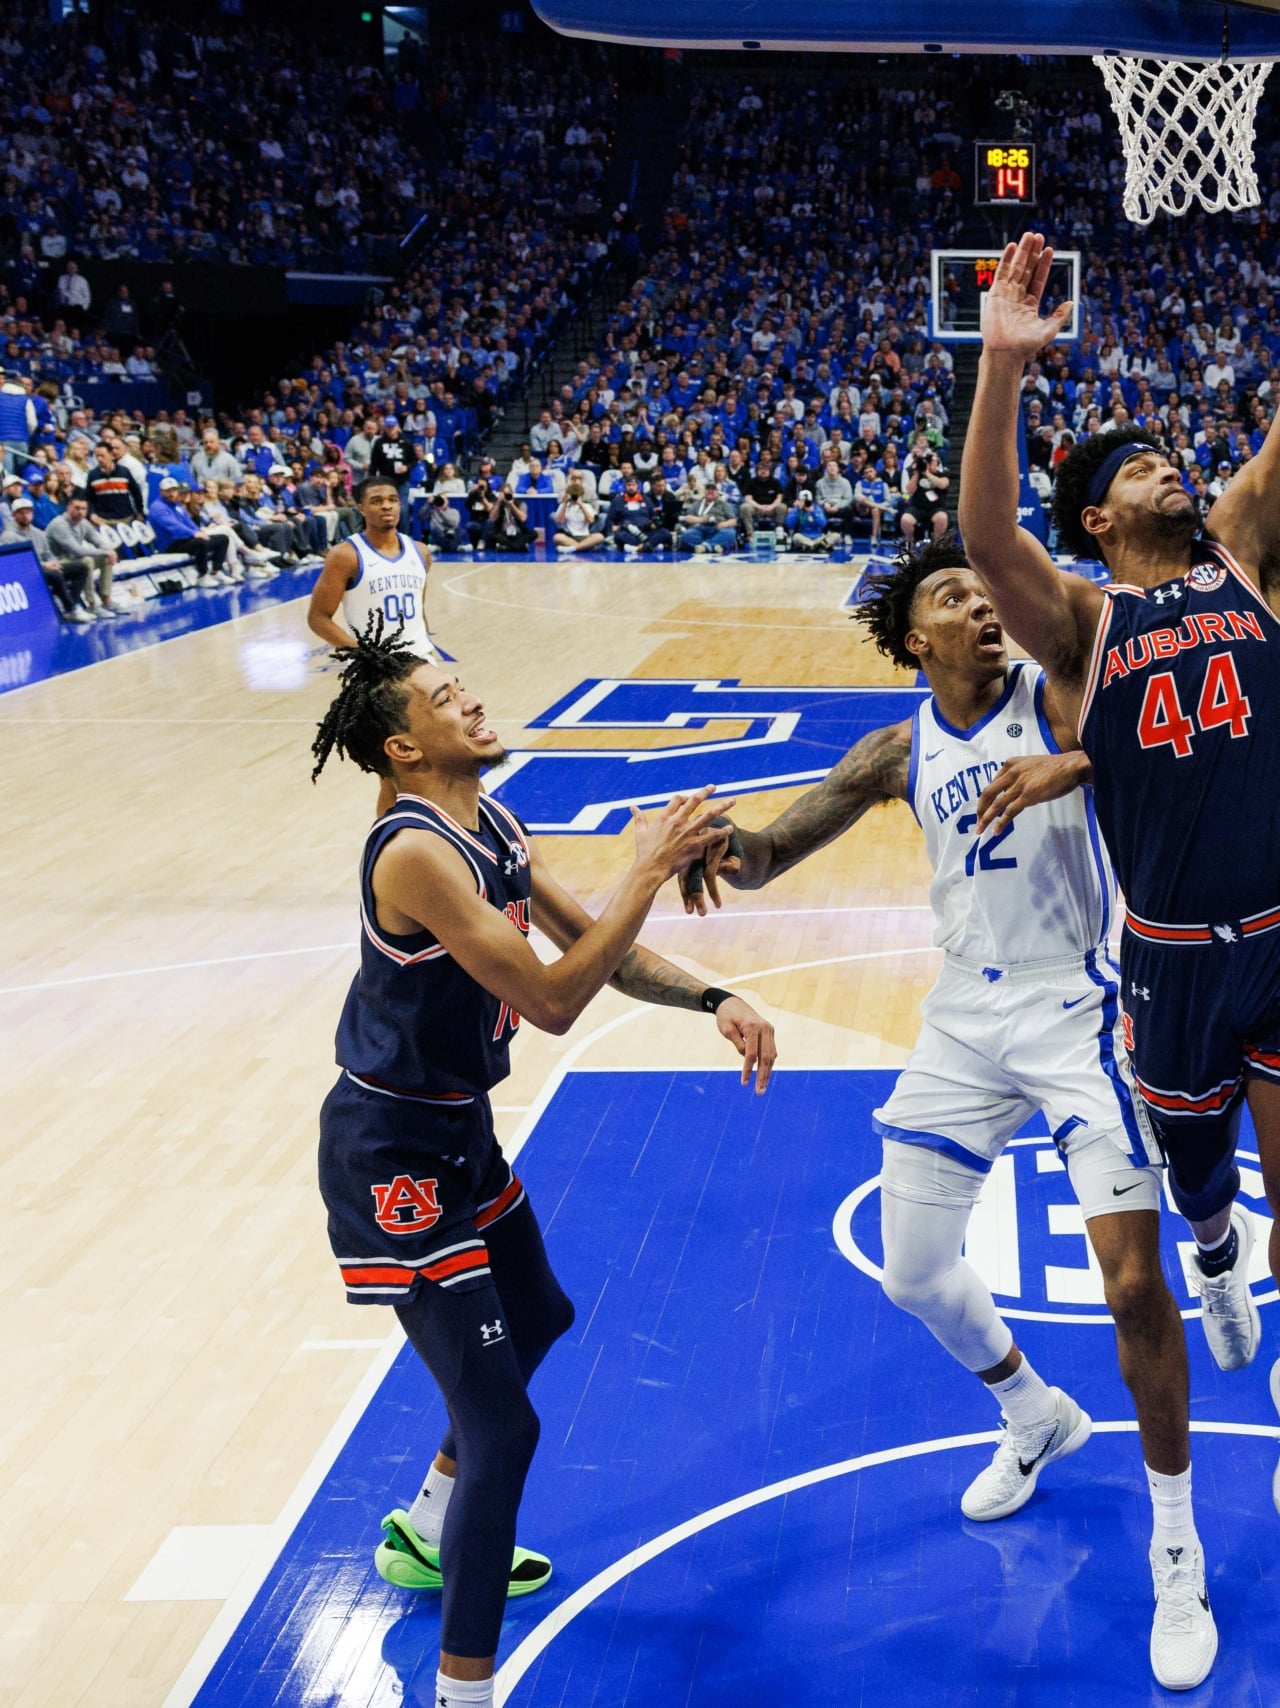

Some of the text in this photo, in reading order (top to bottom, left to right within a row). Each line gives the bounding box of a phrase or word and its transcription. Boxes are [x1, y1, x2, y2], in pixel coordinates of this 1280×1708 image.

[987, 148, 1029, 168] 18:26
[998, 168, 1024, 197] 14
[1191, 563, 1219, 585] SEC
[384, 592, 415, 622] 00
[1103, 610, 1268, 690] AUBURN
[1137, 651, 1252, 759] 44
[1007, 723, 1023, 738] SEC
